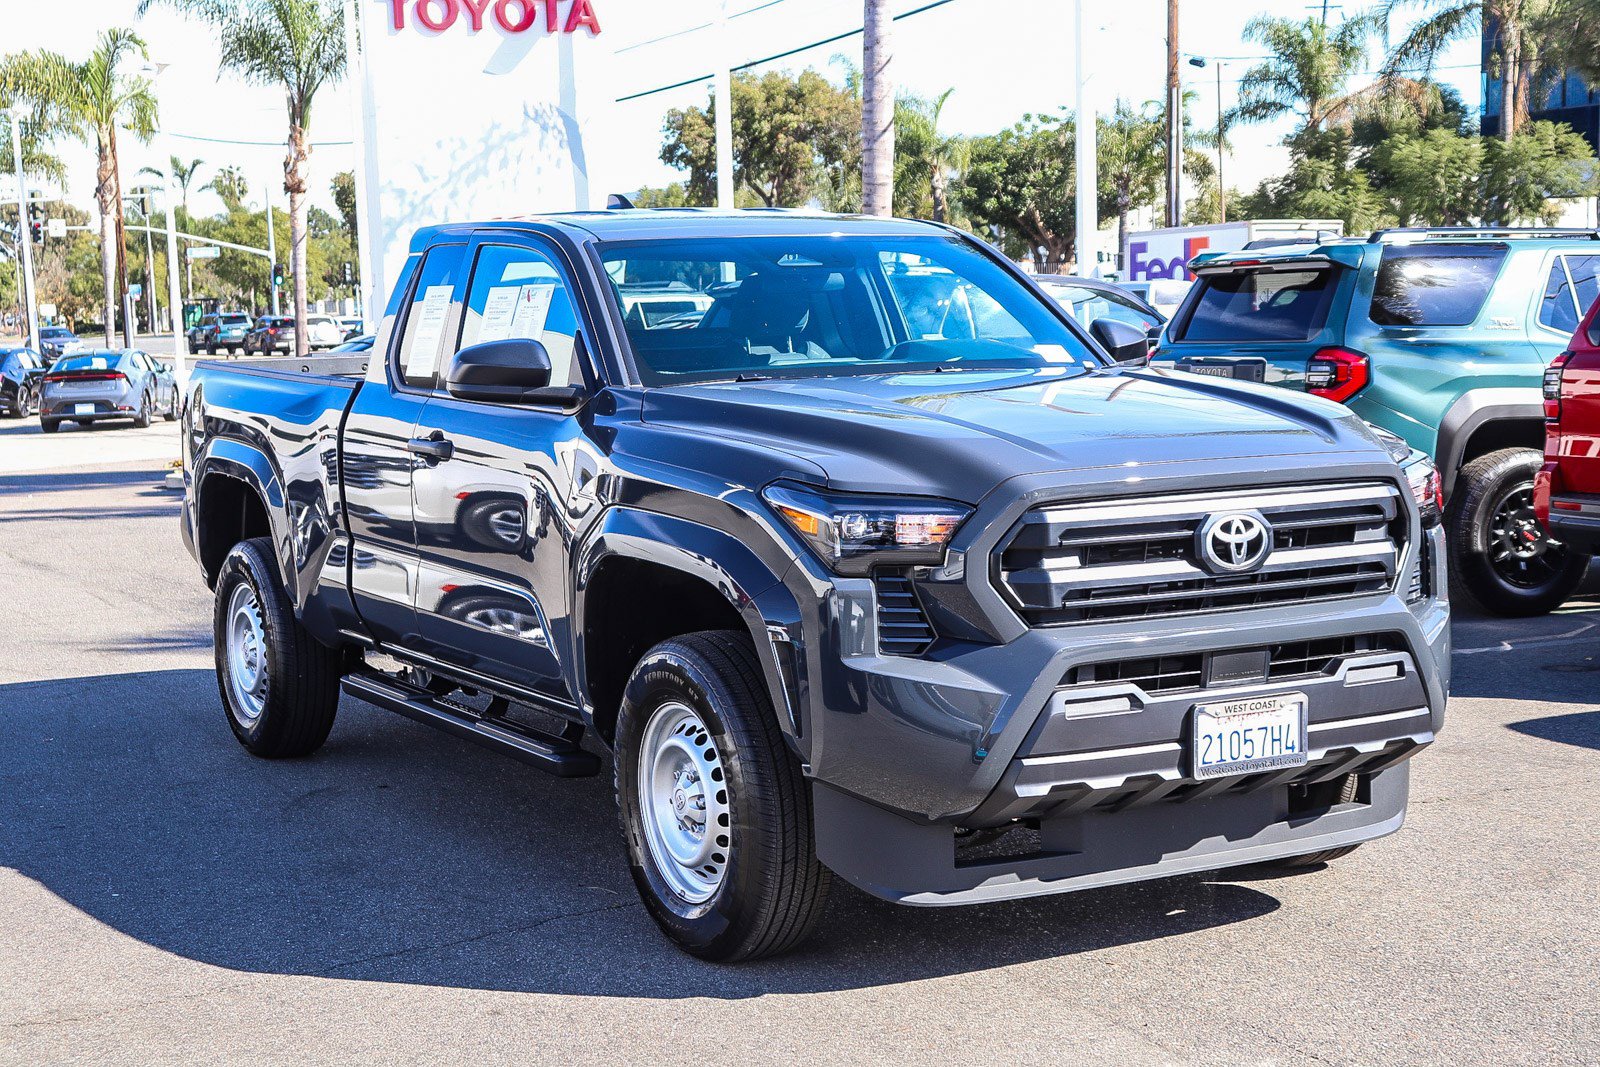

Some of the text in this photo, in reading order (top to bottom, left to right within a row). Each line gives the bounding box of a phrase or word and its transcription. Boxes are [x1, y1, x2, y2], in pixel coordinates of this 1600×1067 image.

[390, 0, 602, 35] TOYOTA
[1195, 367, 1228, 378] TOYOTA
[1224, 700, 1277, 713] WEST COAST
[1202, 723, 1296, 765] 21057H4
